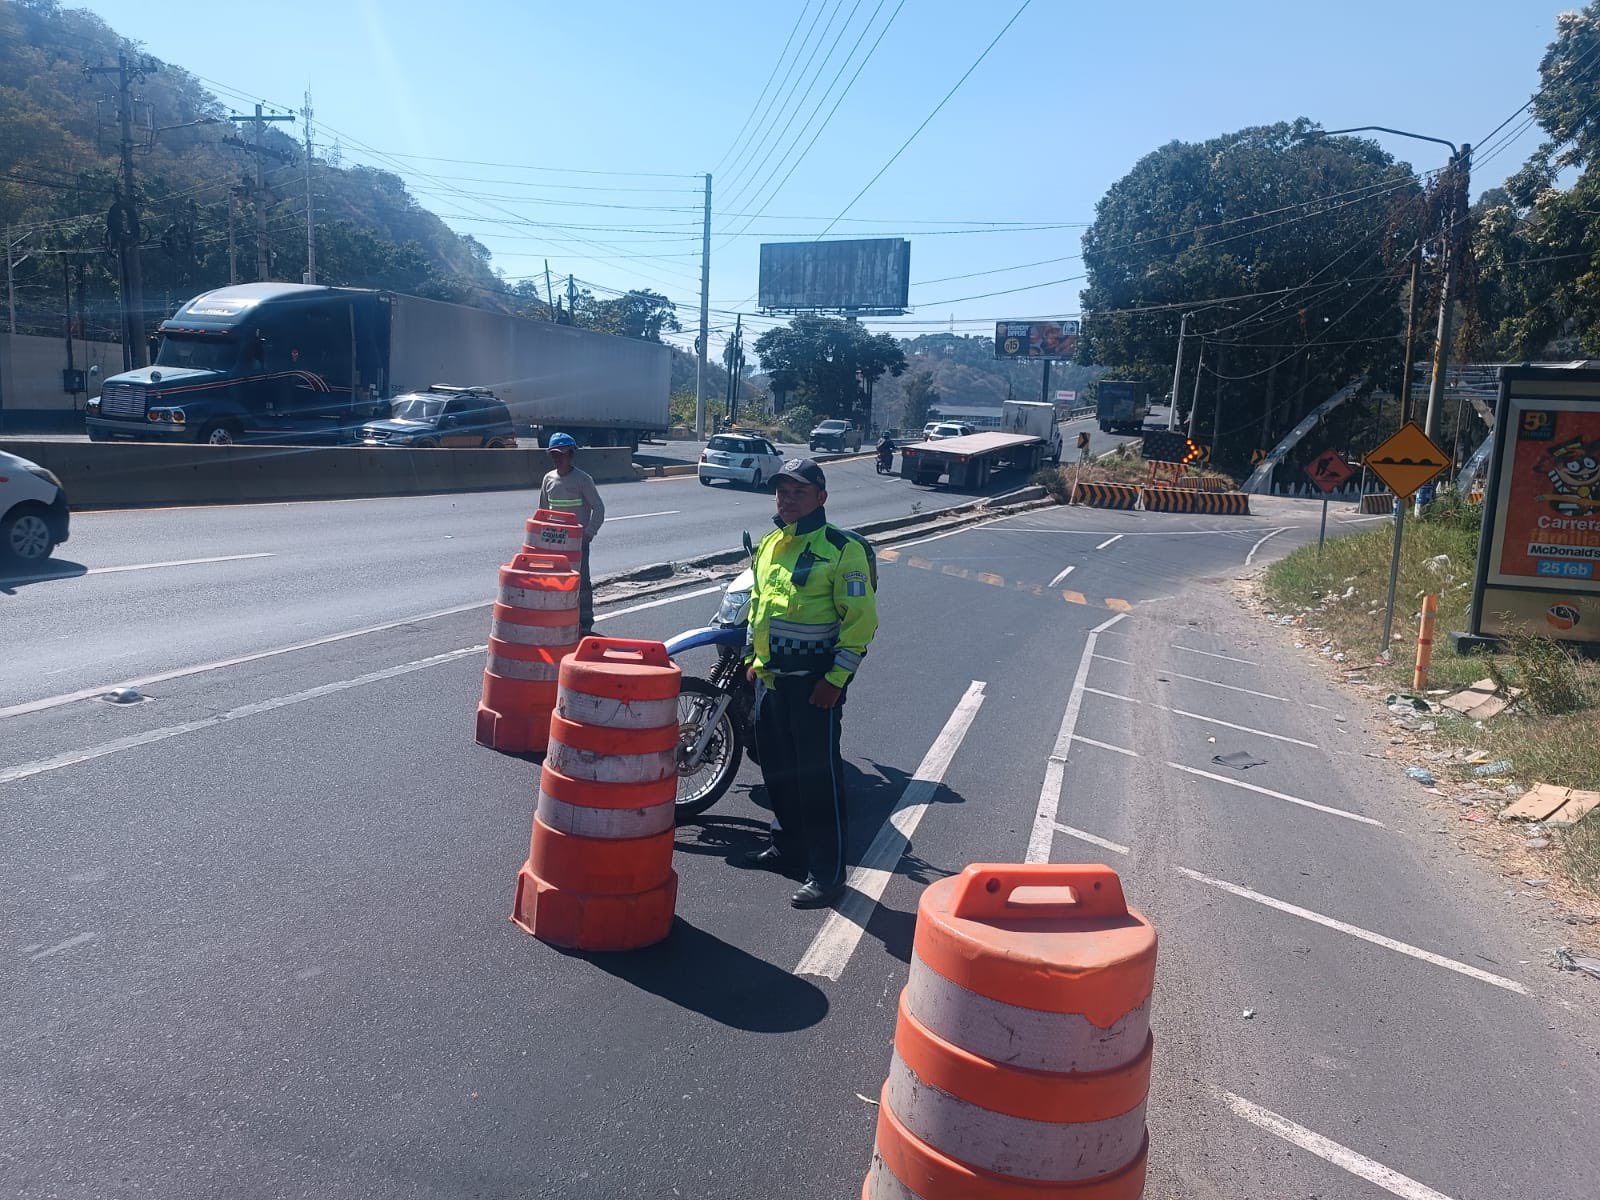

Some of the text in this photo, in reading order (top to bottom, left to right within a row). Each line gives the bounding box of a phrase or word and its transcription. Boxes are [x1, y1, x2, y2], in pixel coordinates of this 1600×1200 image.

[1530, 545, 1600, 558] McDonald's
[1542, 562, 1589, 576] 25 feb
